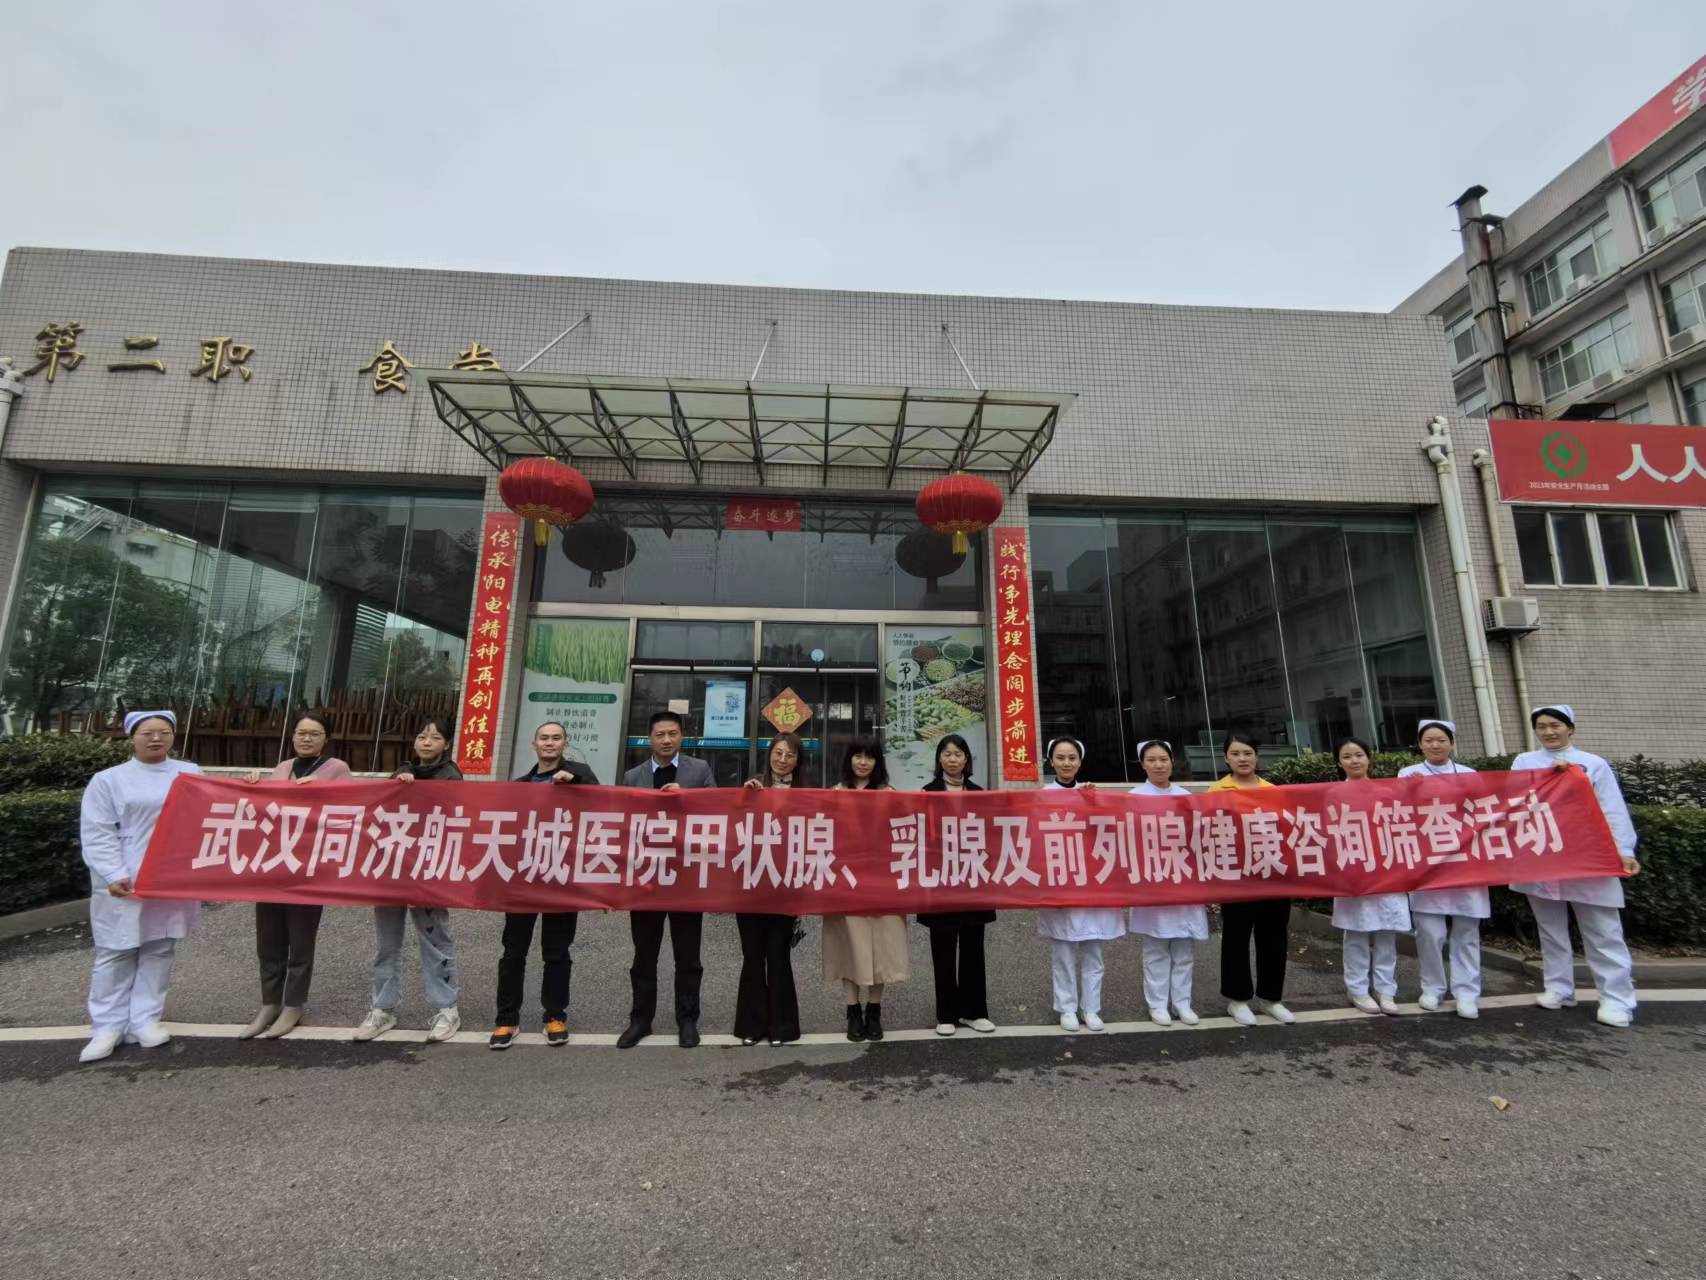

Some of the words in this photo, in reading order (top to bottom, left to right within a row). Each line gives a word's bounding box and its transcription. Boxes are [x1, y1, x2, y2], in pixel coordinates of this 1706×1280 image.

[22, 320, 255, 384] 第二职
[1616, 444, 1706, 483] 人人
[773, 698, 801, 726] 福
[191, 789, 1564, 890] 武汉同济航天城医院甲状腺、乳腺及前列腺健康咨询筛查活动
